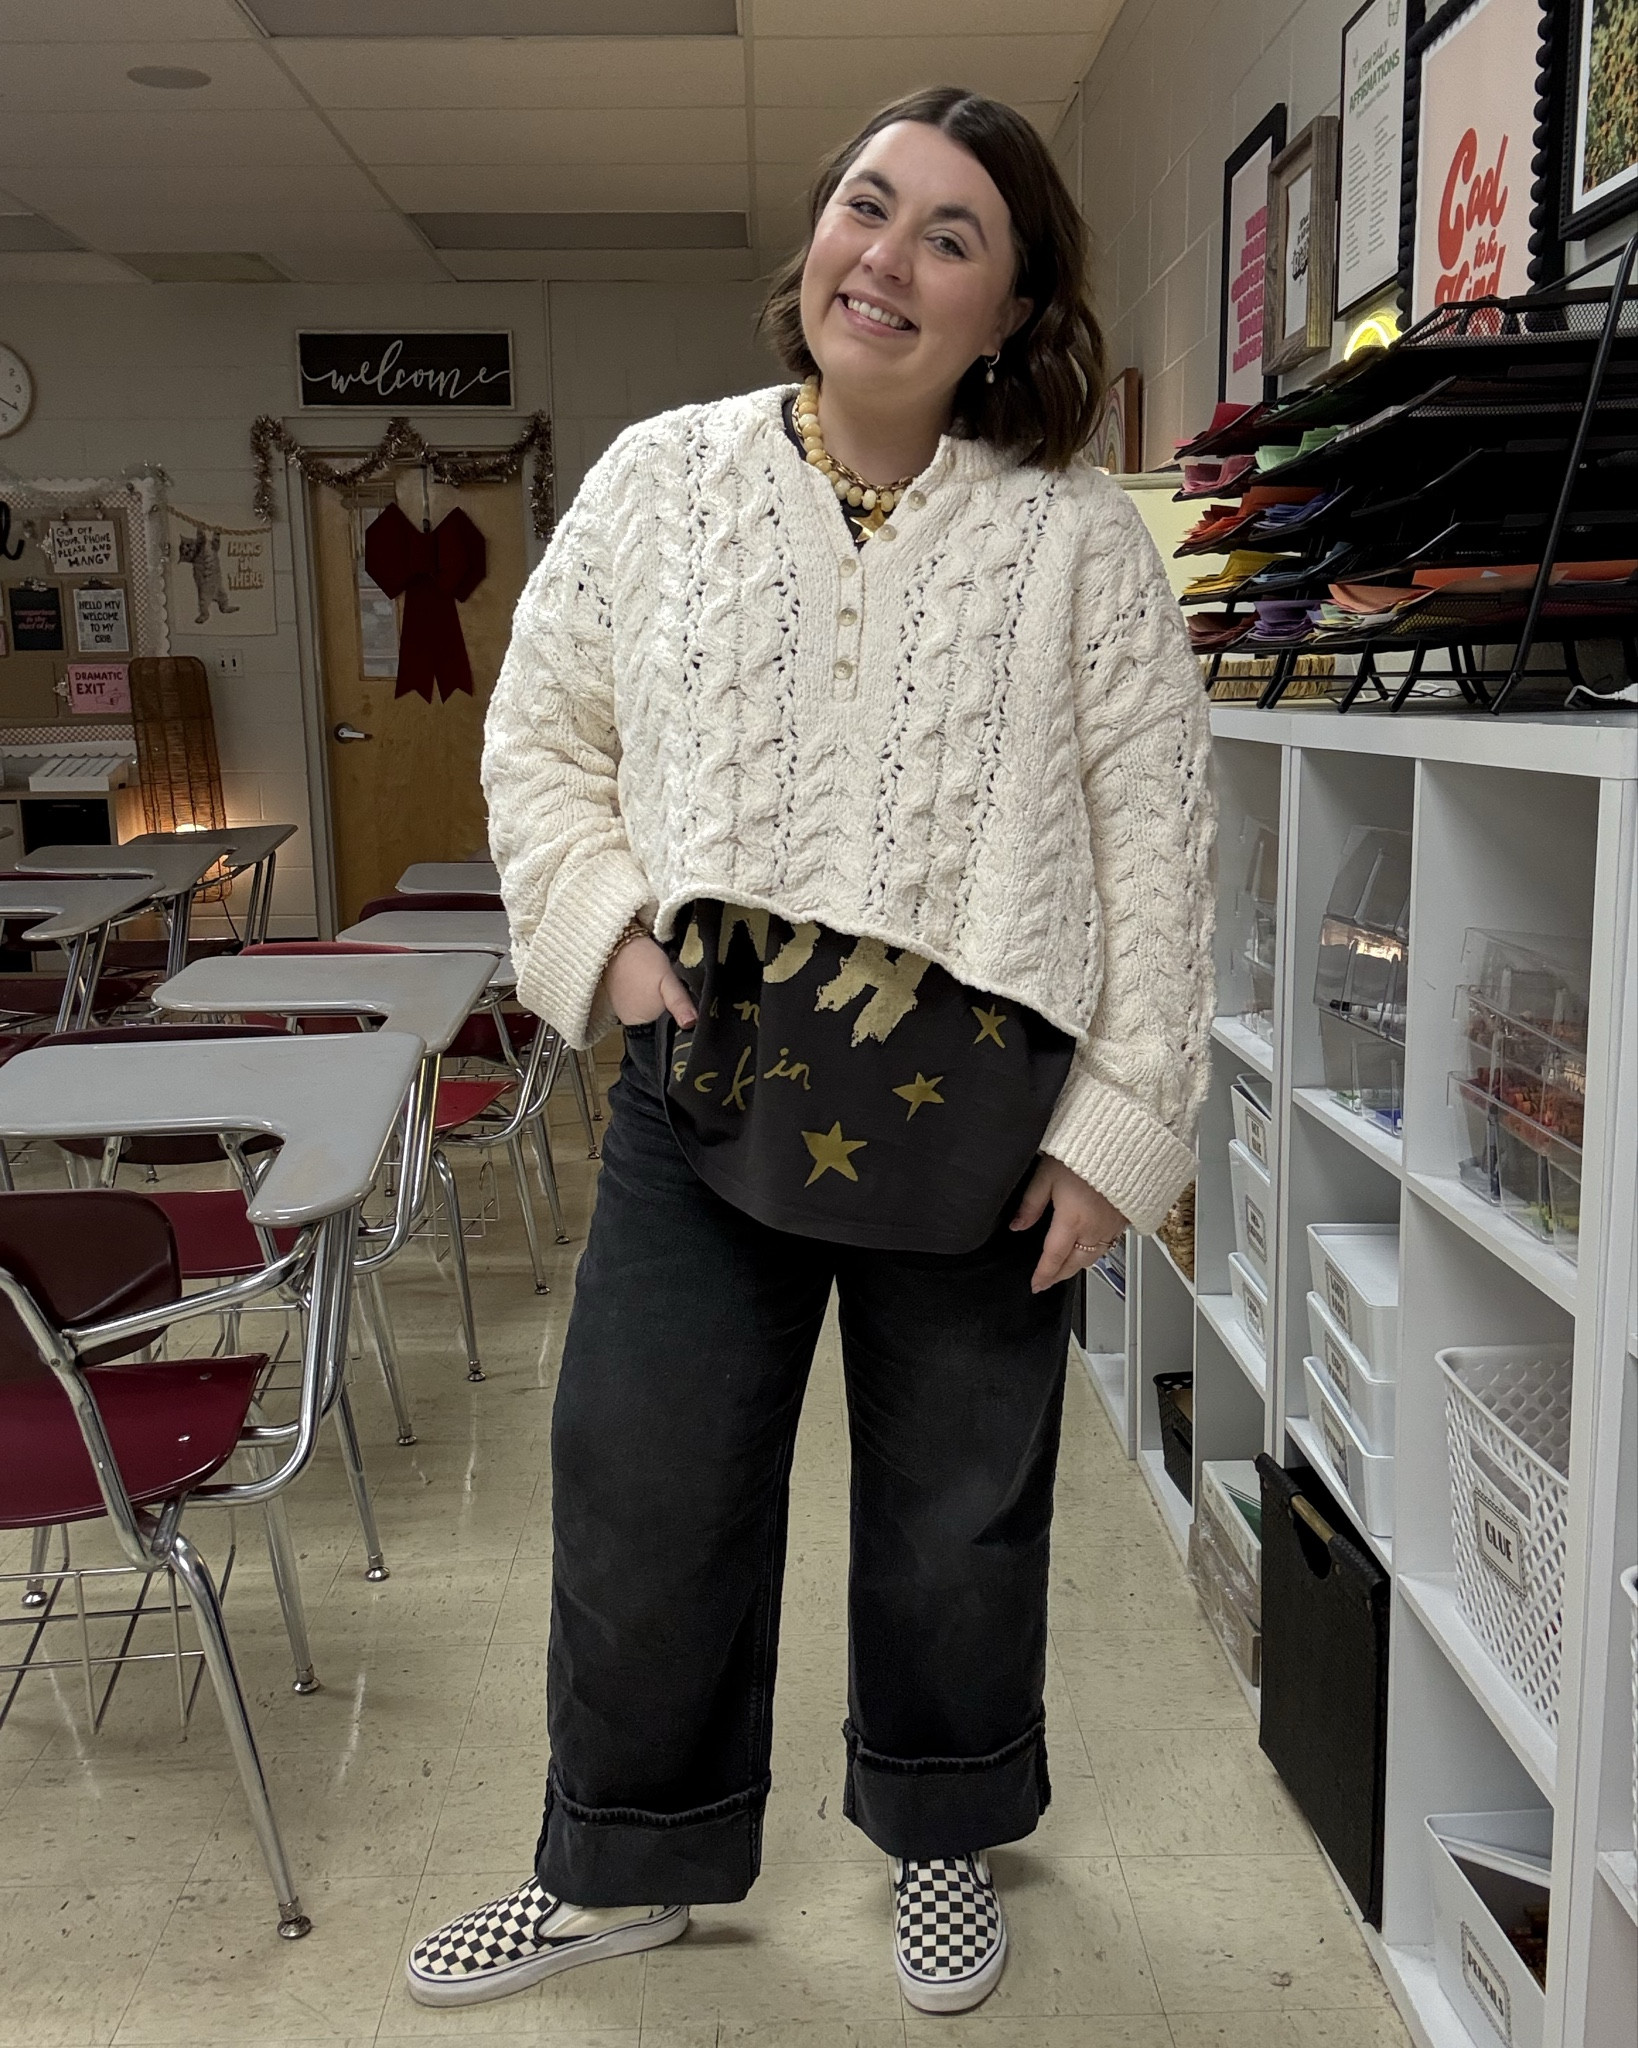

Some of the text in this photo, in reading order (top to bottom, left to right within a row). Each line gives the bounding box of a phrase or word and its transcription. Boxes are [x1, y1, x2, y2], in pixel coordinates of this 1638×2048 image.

[1349, 48, 1400, 113] AFFIRMATIONS
[1438, 128, 1508, 270] Cool
[1474, 229, 1498, 270] to be
[8, 367, 16, 377] 2
[301, 339, 510, 399] welcome
[15, 384, 22, 394] 3
[77, 526, 92, 535] OFF
[56, 533, 111, 548] YOUR PHONE
[58, 543, 112, 558] PLEASE AND
[68, 554, 104, 567] HANG
[79, 600, 120, 610] HELLO MTV
[82, 612, 119, 621] WELCOME
[90, 623, 114, 632] TO MY
[95, 634, 112, 643] CRIB
[75, 672, 123, 680] DRAMATIC
[76, 683, 106, 695] EXIT
[1484, 1519, 1514, 1564] GLUE
[1467, 1950, 1504, 2017] PENCILS
